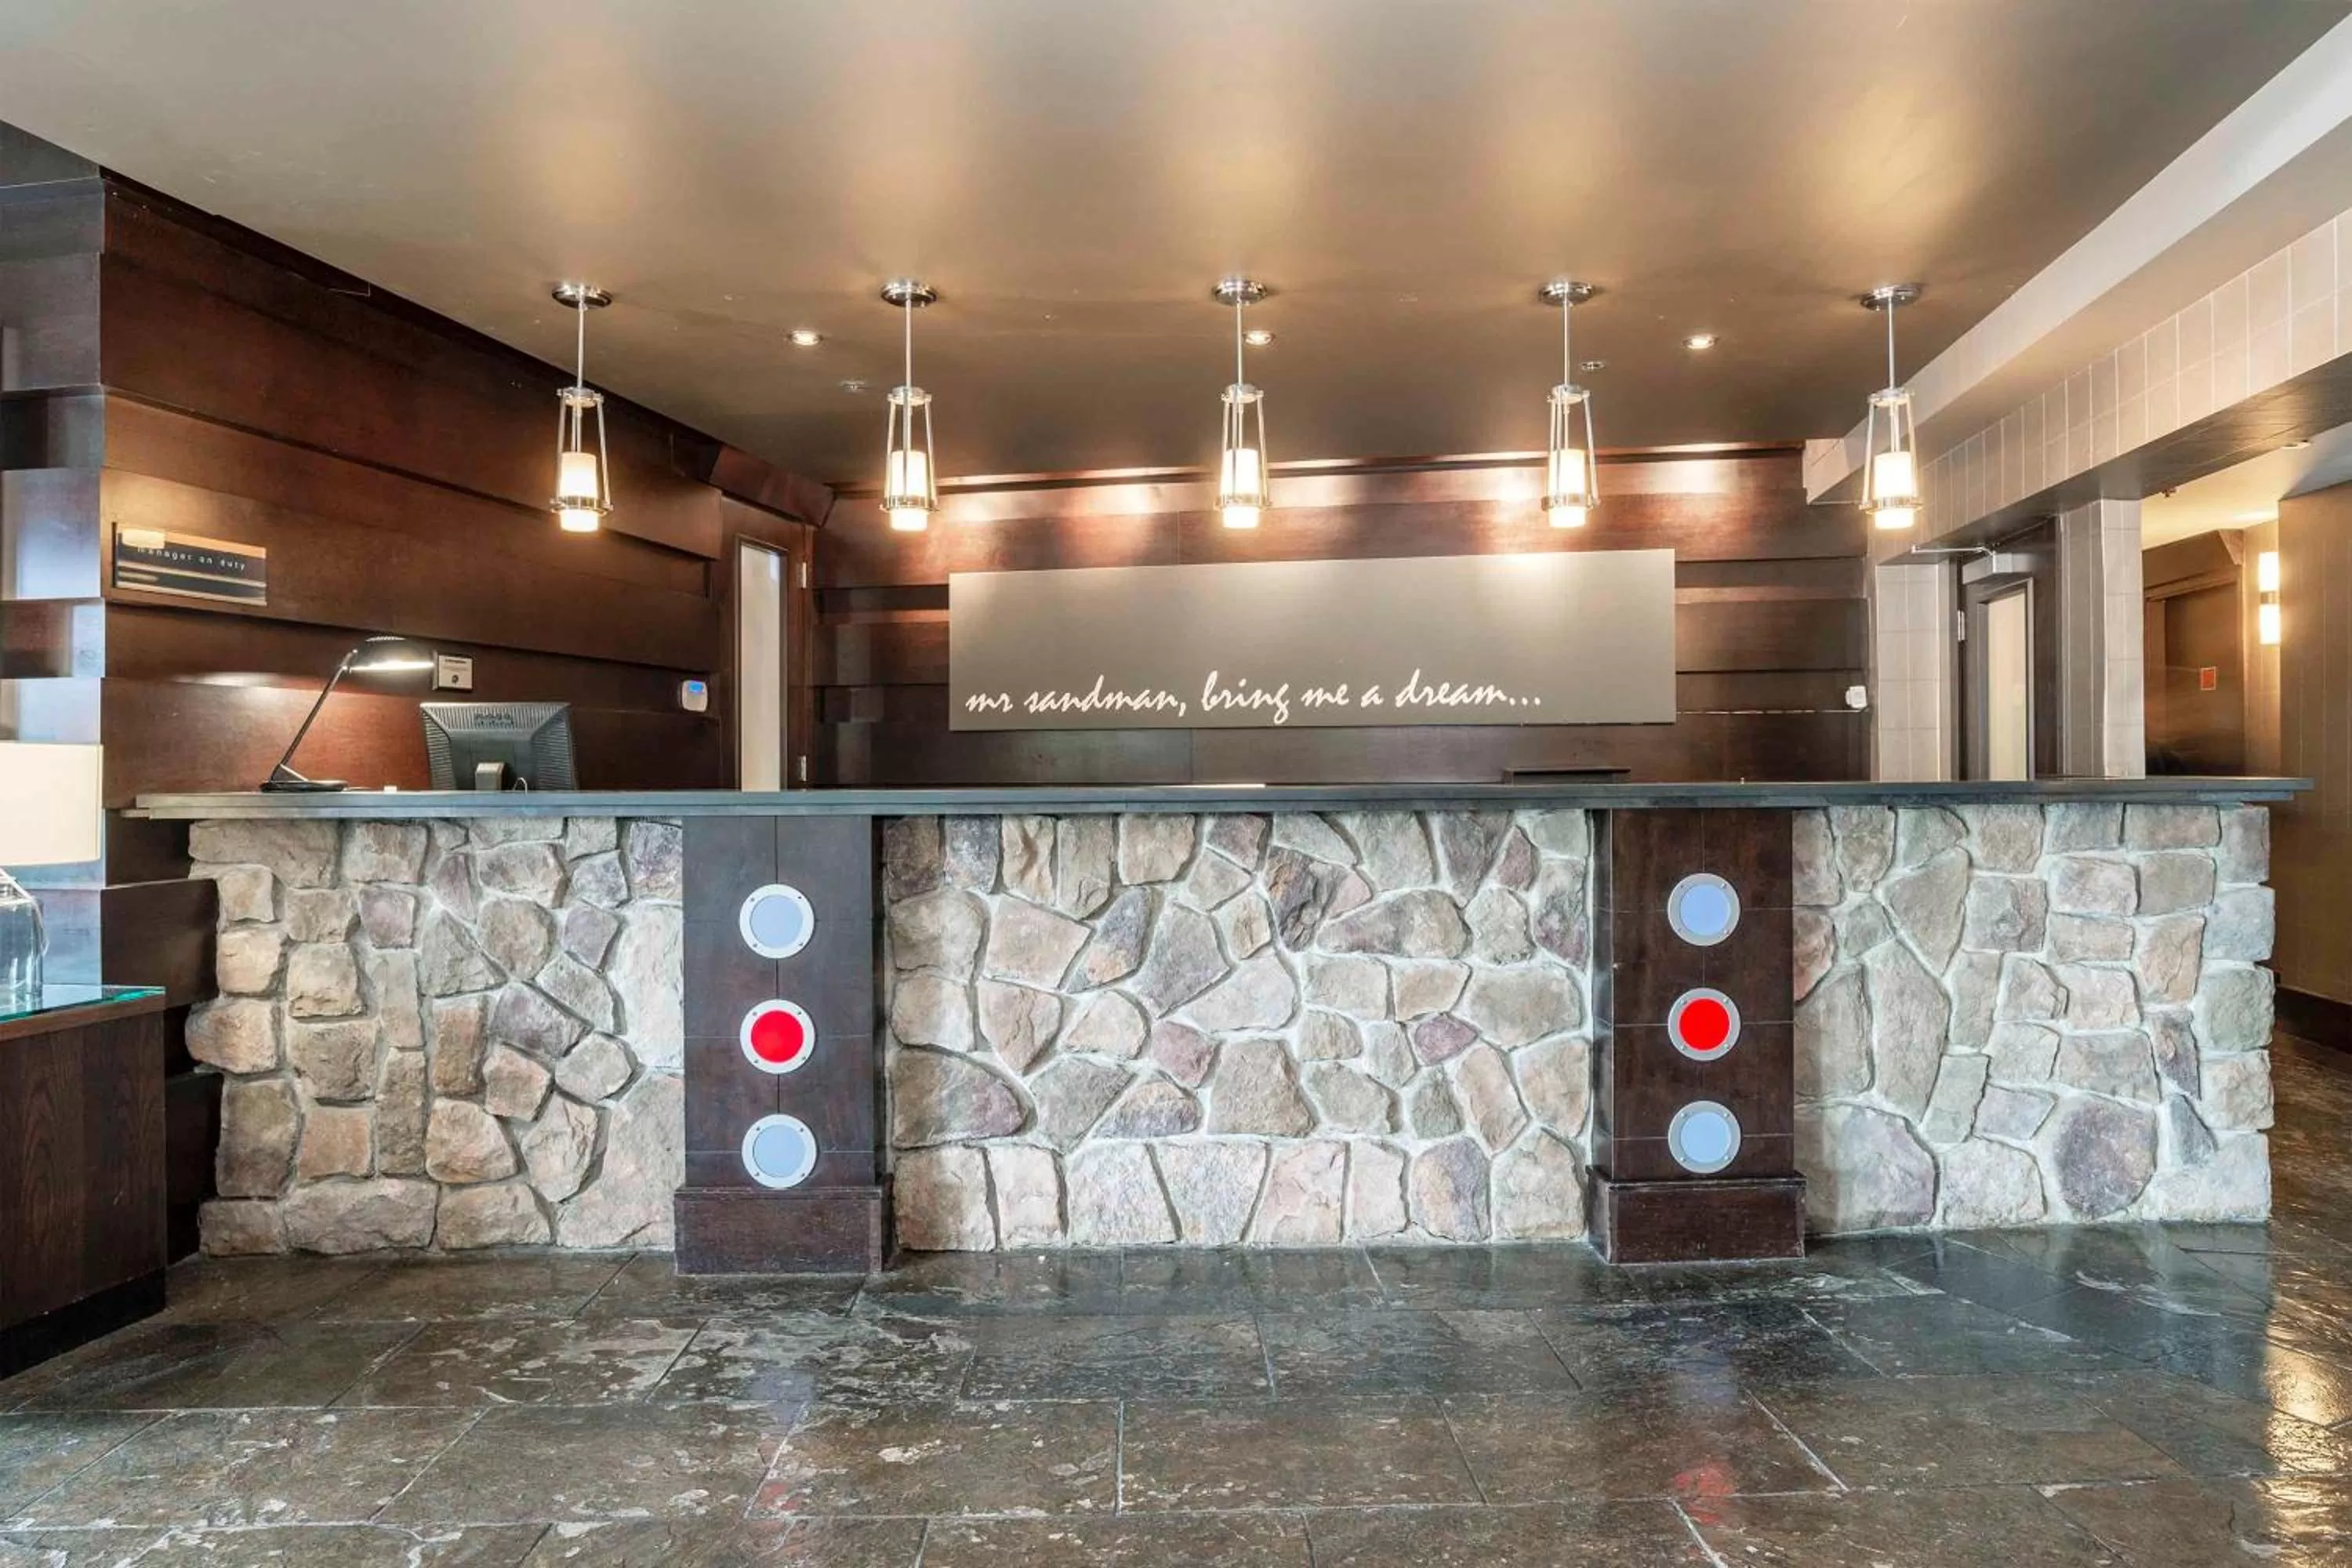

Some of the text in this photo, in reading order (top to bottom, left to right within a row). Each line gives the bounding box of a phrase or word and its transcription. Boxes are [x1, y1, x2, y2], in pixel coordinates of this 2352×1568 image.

[965, 668, 1541, 724] mr sandman, bring me a dream...
